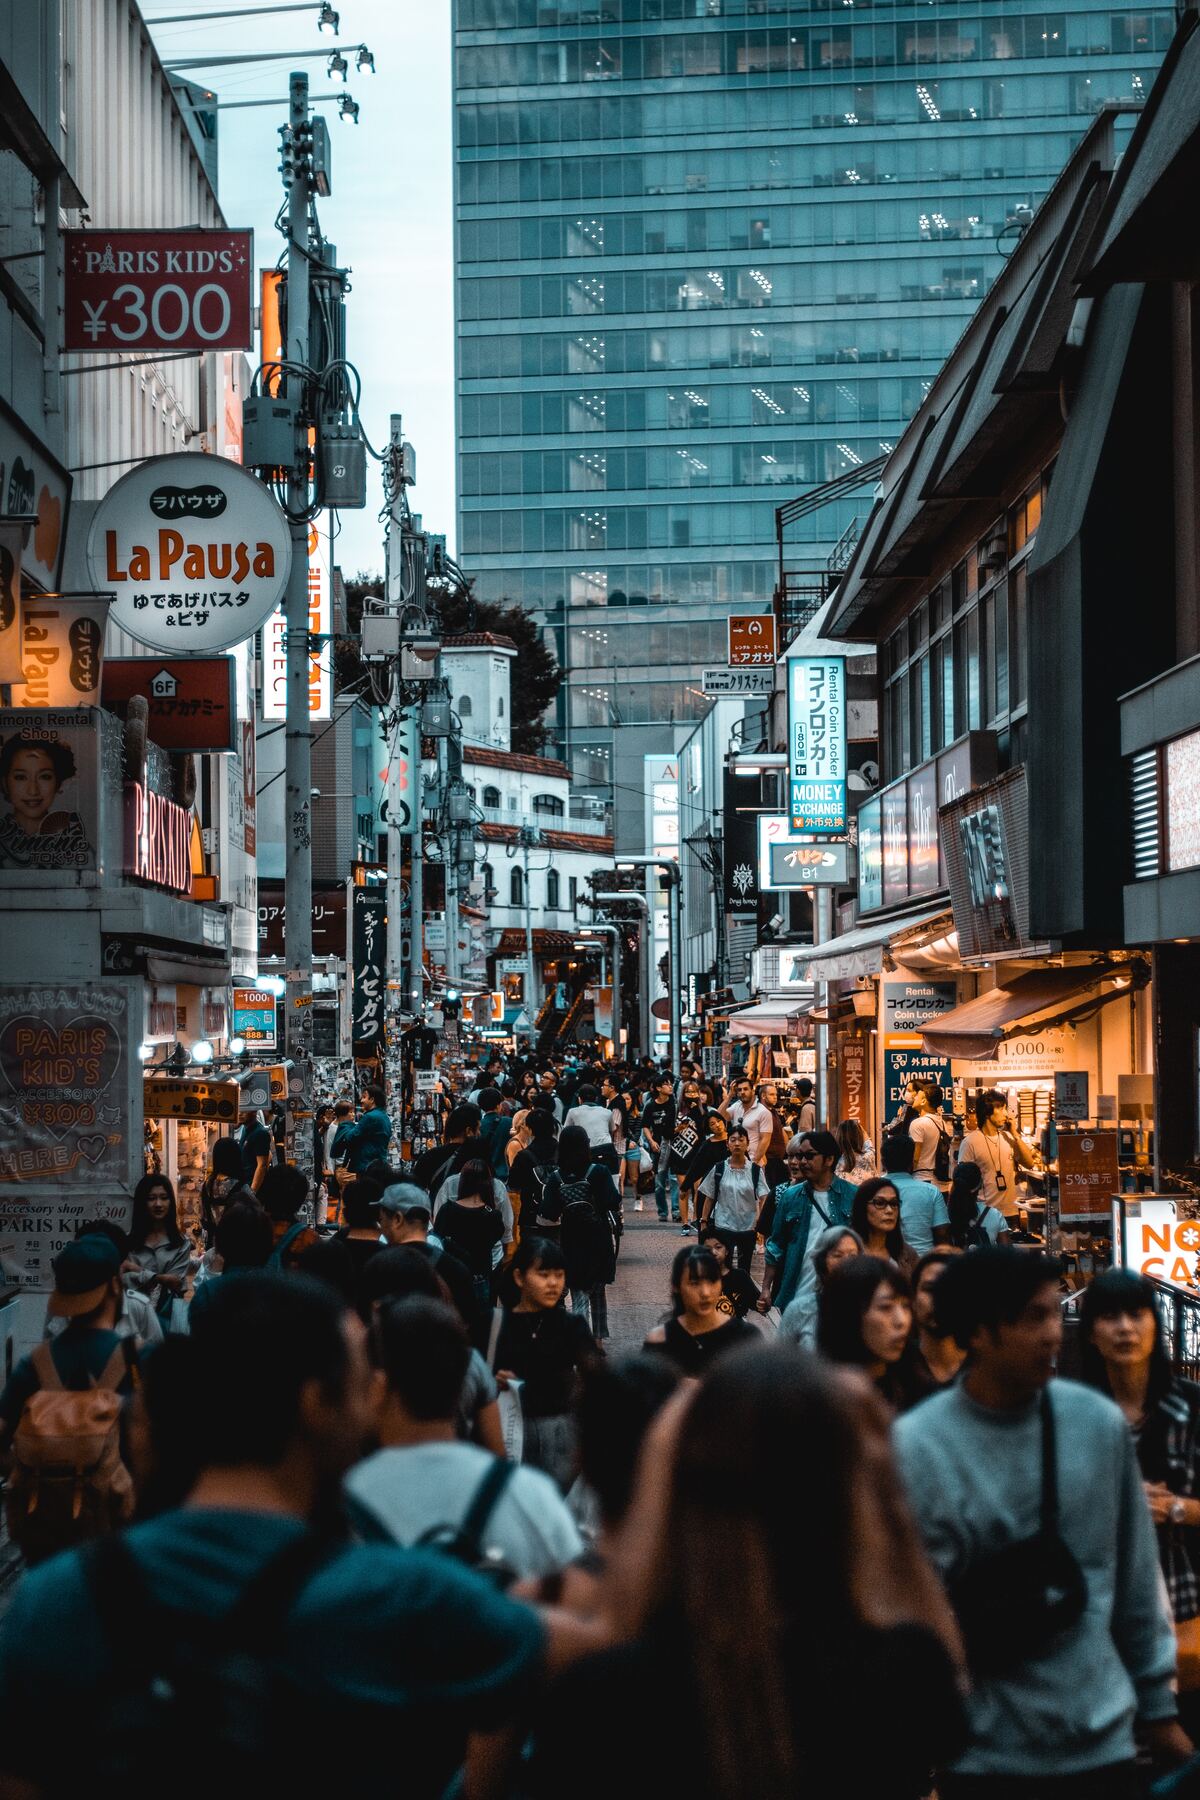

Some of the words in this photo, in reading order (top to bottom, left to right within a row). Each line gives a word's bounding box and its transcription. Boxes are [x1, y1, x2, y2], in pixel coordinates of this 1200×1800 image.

[85, 245, 160, 274] PARIS
[165, 250, 233, 274] KID'S
[81, 283, 231, 342] ¥300
[153, 494, 224, 510] ラパウザ
[106, 530, 151, 582] La
[158, 528, 275, 585] Pausa
[133, 591, 250, 609] ゆであげパスタ
[166, 610, 210, 626] &ピザ
[740, 652, 773, 663] アガサ
[155, 680, 173, 693] 6F
[729, 674, 772, 691] クリスティー
[829, 666, 839, 703] Rental
[47, 712, 92, 726] Rental
[809, 666, 825, 776] コインロッカー
[829, 706, 840, 733] Coin
[22, 727, 58, 741] Shop
[829, 736, 840, 777] Locker
[793, 784, 843, 801] MONEY
[792, 803, 843, 815] EXCHANGE
[30, 851, 89, 866] TOKYO
[802, 866, 818, 879] B1
[905, 987, 934, 996] Rental
[887, 998, 954, 1009] コインロッカー
[894, 1010, 914, 1019] Coin
[16, 1028, 107, 1056] PARIS
[23, 1058, 101, 1086] KID'S
[23, 1103, 96, 1126] ¥300
[57, 1203, 84, 1216] shop
